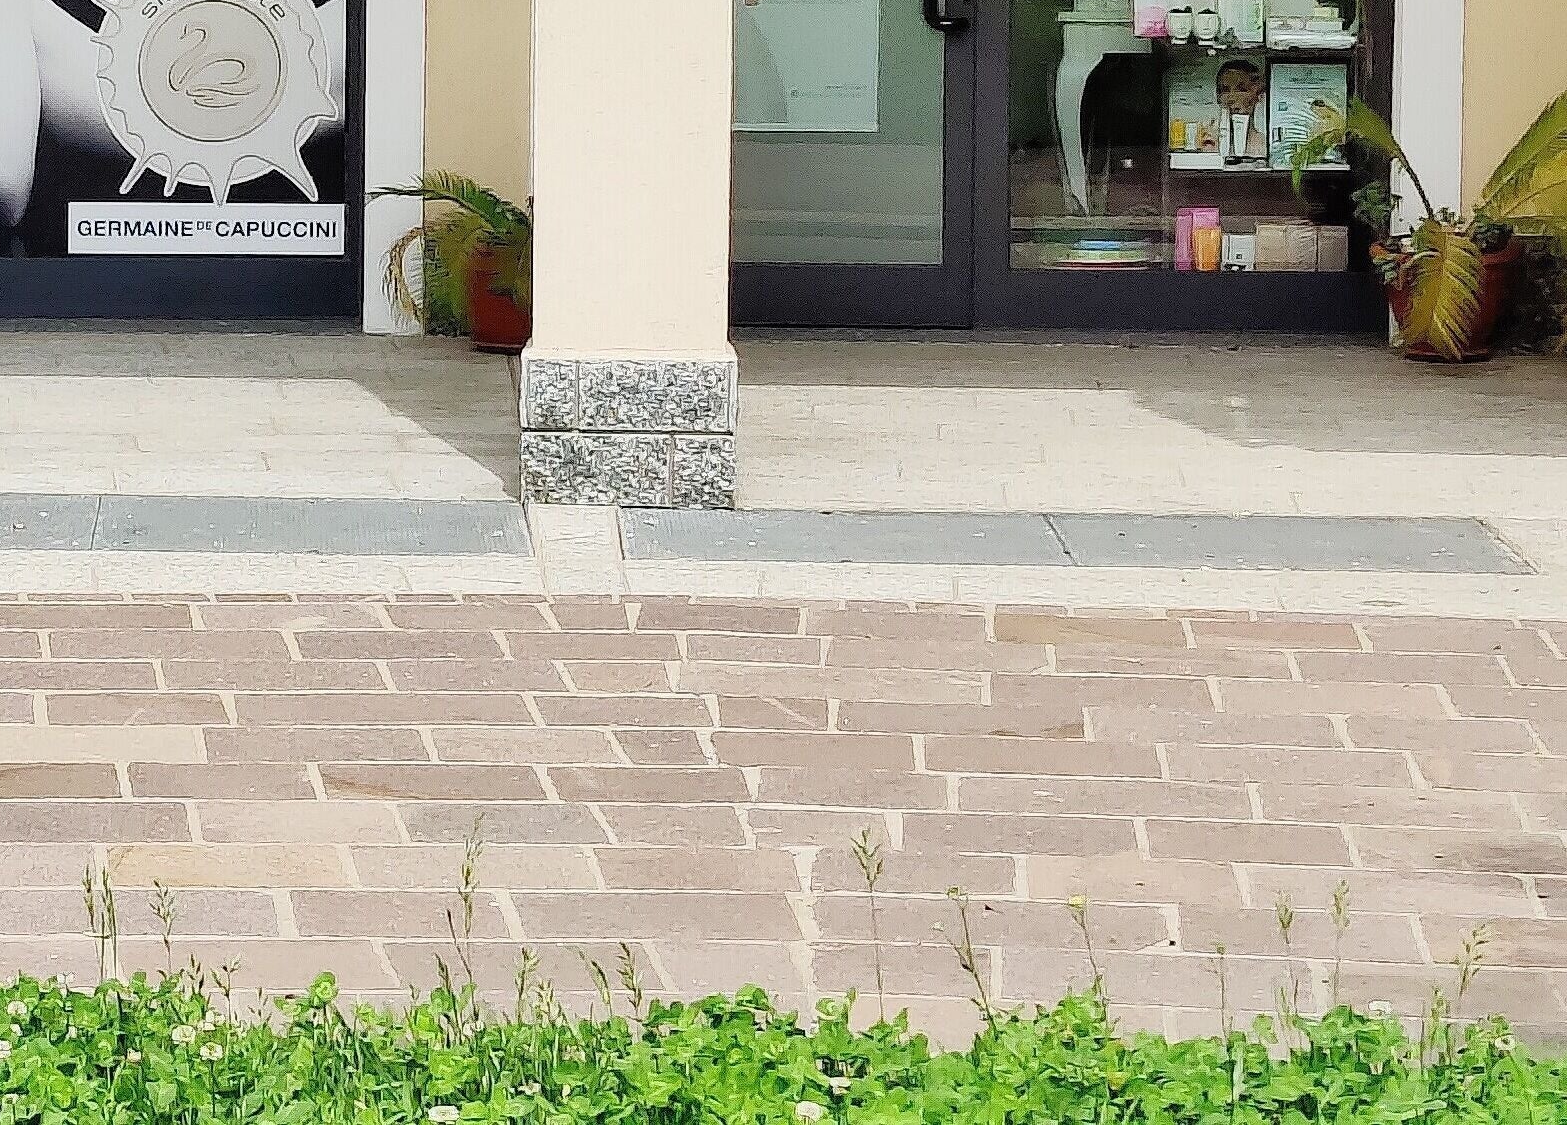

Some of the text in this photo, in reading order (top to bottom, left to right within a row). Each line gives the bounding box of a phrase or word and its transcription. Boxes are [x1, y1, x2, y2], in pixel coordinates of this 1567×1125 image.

[77, 220, 338, 239] GERMAINE DE CAPUCCINI
